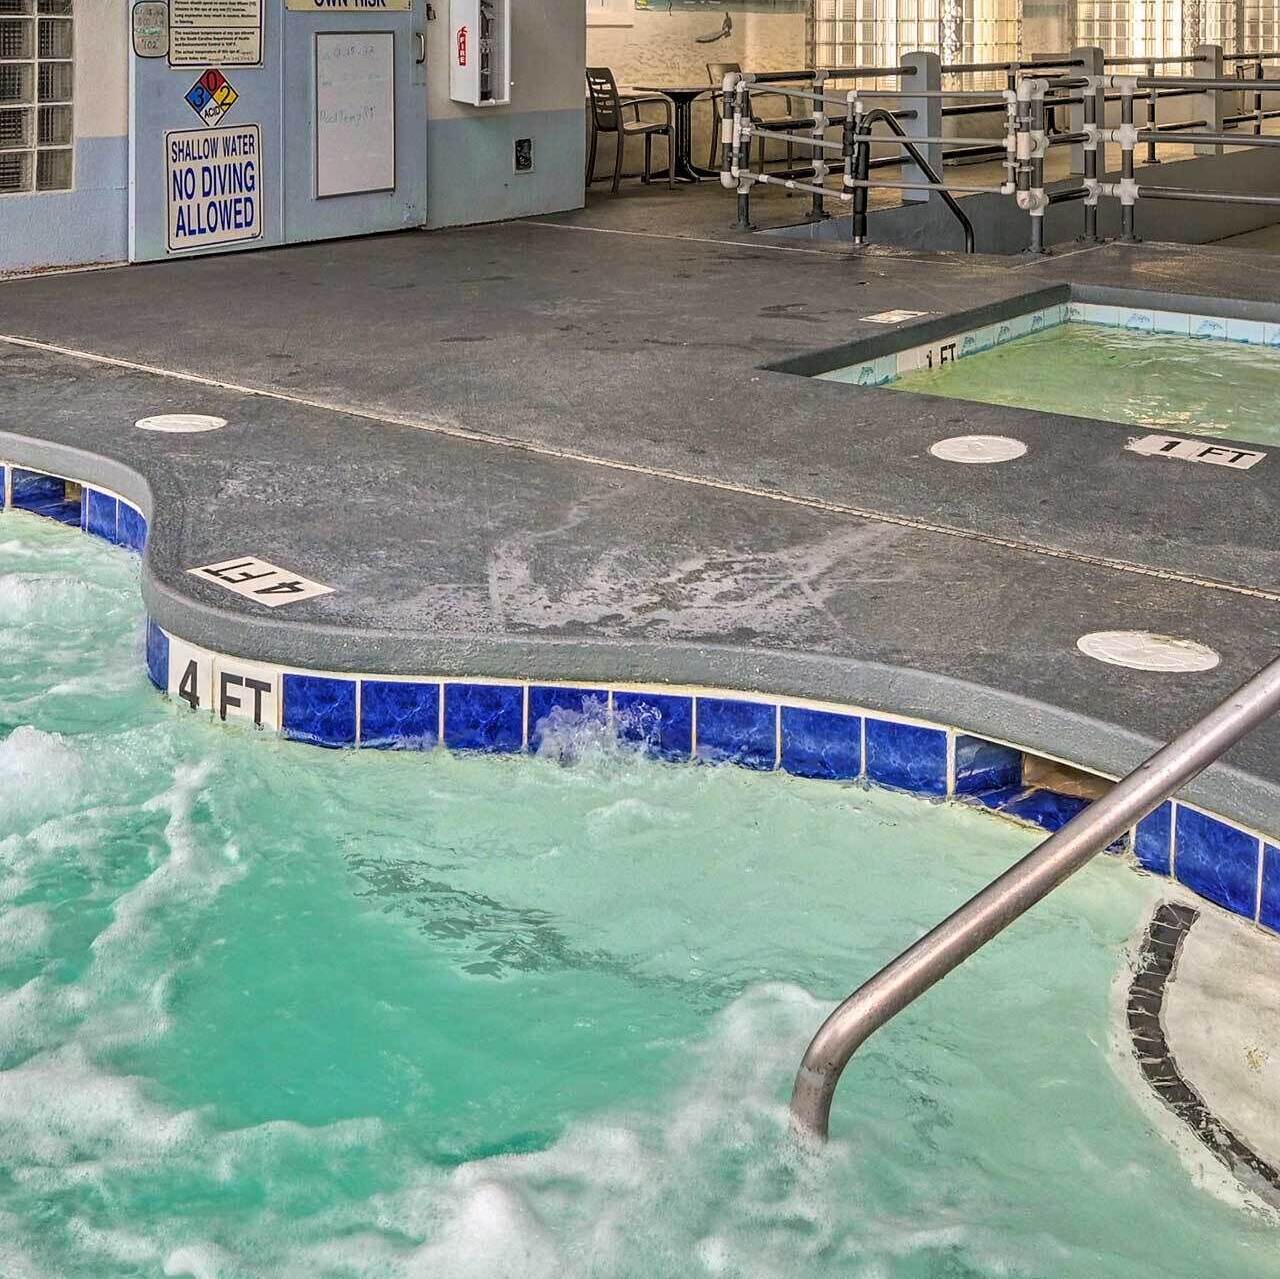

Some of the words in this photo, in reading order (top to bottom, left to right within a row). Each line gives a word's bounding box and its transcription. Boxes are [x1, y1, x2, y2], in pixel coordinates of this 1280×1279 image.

[206, 71, 217, 92] 0
[193, 87, 204, 107] 3
[220, 85, 231, 106] 2
[205, 106, 220, 118] ACID
[172, 137, 218, 163] SHALLOW
[223, 134, 255, 157] WATER
[173, 167, 196, 202] NO
[202, 161, 255, 198] DIVING
[175, 196, 254, 237] ALLOWED
[926, 350, 933, 369] 1
[940, 343, 956, 365] FT
[1159, 440, 1182, 452] 1
[1196, 446, 1256, 464] FT
[201, 562, 277, 584] FT
[253, 581, 305, 595] 4
[179, 659, 200, 710] 4
[220, 672, 272, 726] FT
